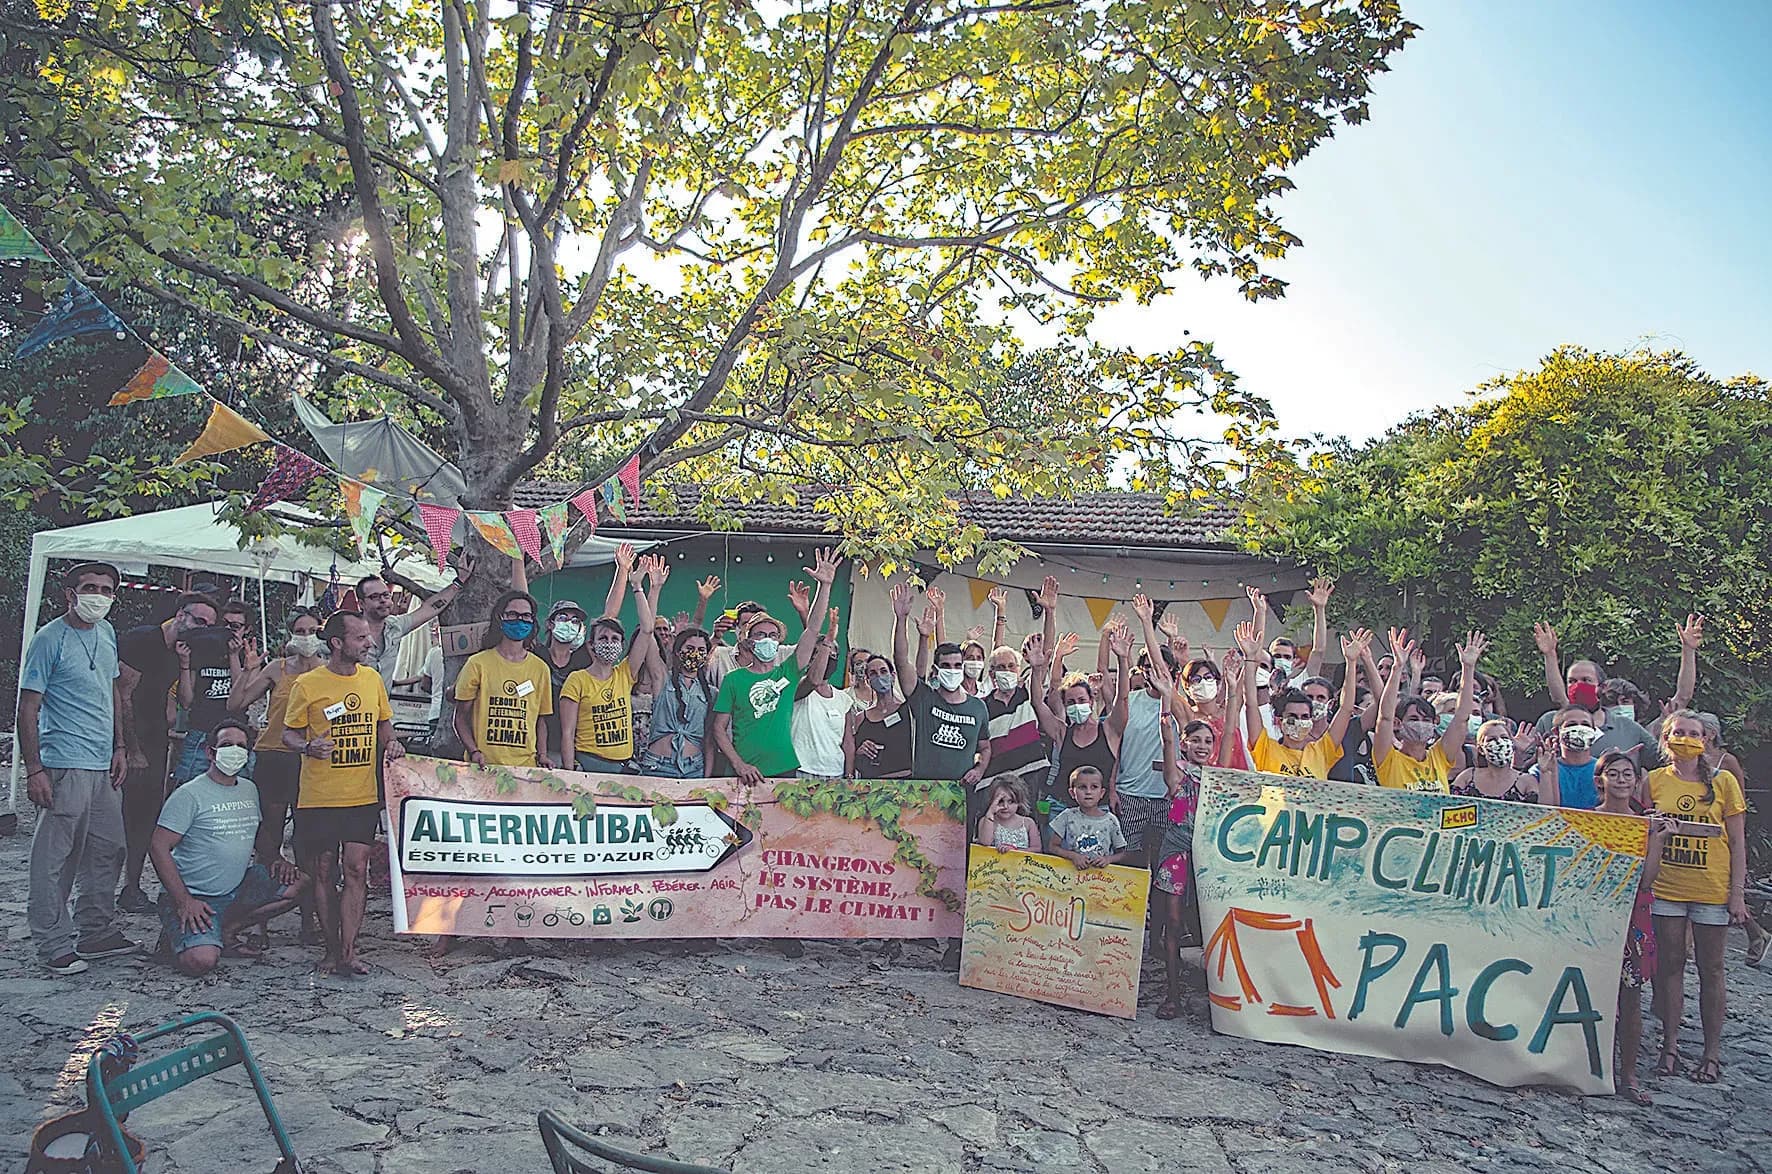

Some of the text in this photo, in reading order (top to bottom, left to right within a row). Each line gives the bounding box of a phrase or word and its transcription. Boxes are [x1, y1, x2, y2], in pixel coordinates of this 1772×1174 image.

[490, 696, 517, 708] DEBOUT
[488, 718, 512, 729] POUR
[931, 707, 976, 726] ALTERNATIBA
[594, 721, 616, 732] POUR
[487, 729, 527, 745] CLIMAT
[331, 748, 372, 764] CLIMAT
[411, 809, 655, 845] ALTERNATIBA
[1696, 840, 1708, 850] LE
[523, 851, 576, 863] CÔTE
[584, 851, 654, 863] D'AZUR
[761, 850, 895, 876] CHANGEONS
[1217, 804, 1573, 909] CAMP CLIMAT
[1662, 847, 1708, 865] CLIMAT
[710, 875, 741, 890] AGIR
[759, 870, 898, 901] LE SYSTÈME,
[755, 893, 797, 910] PAS
[804, 896, 833, 913] LE
[839, 900, 921, 921] CLIMAT
[1347, 929, 1603, 1080] PACA
